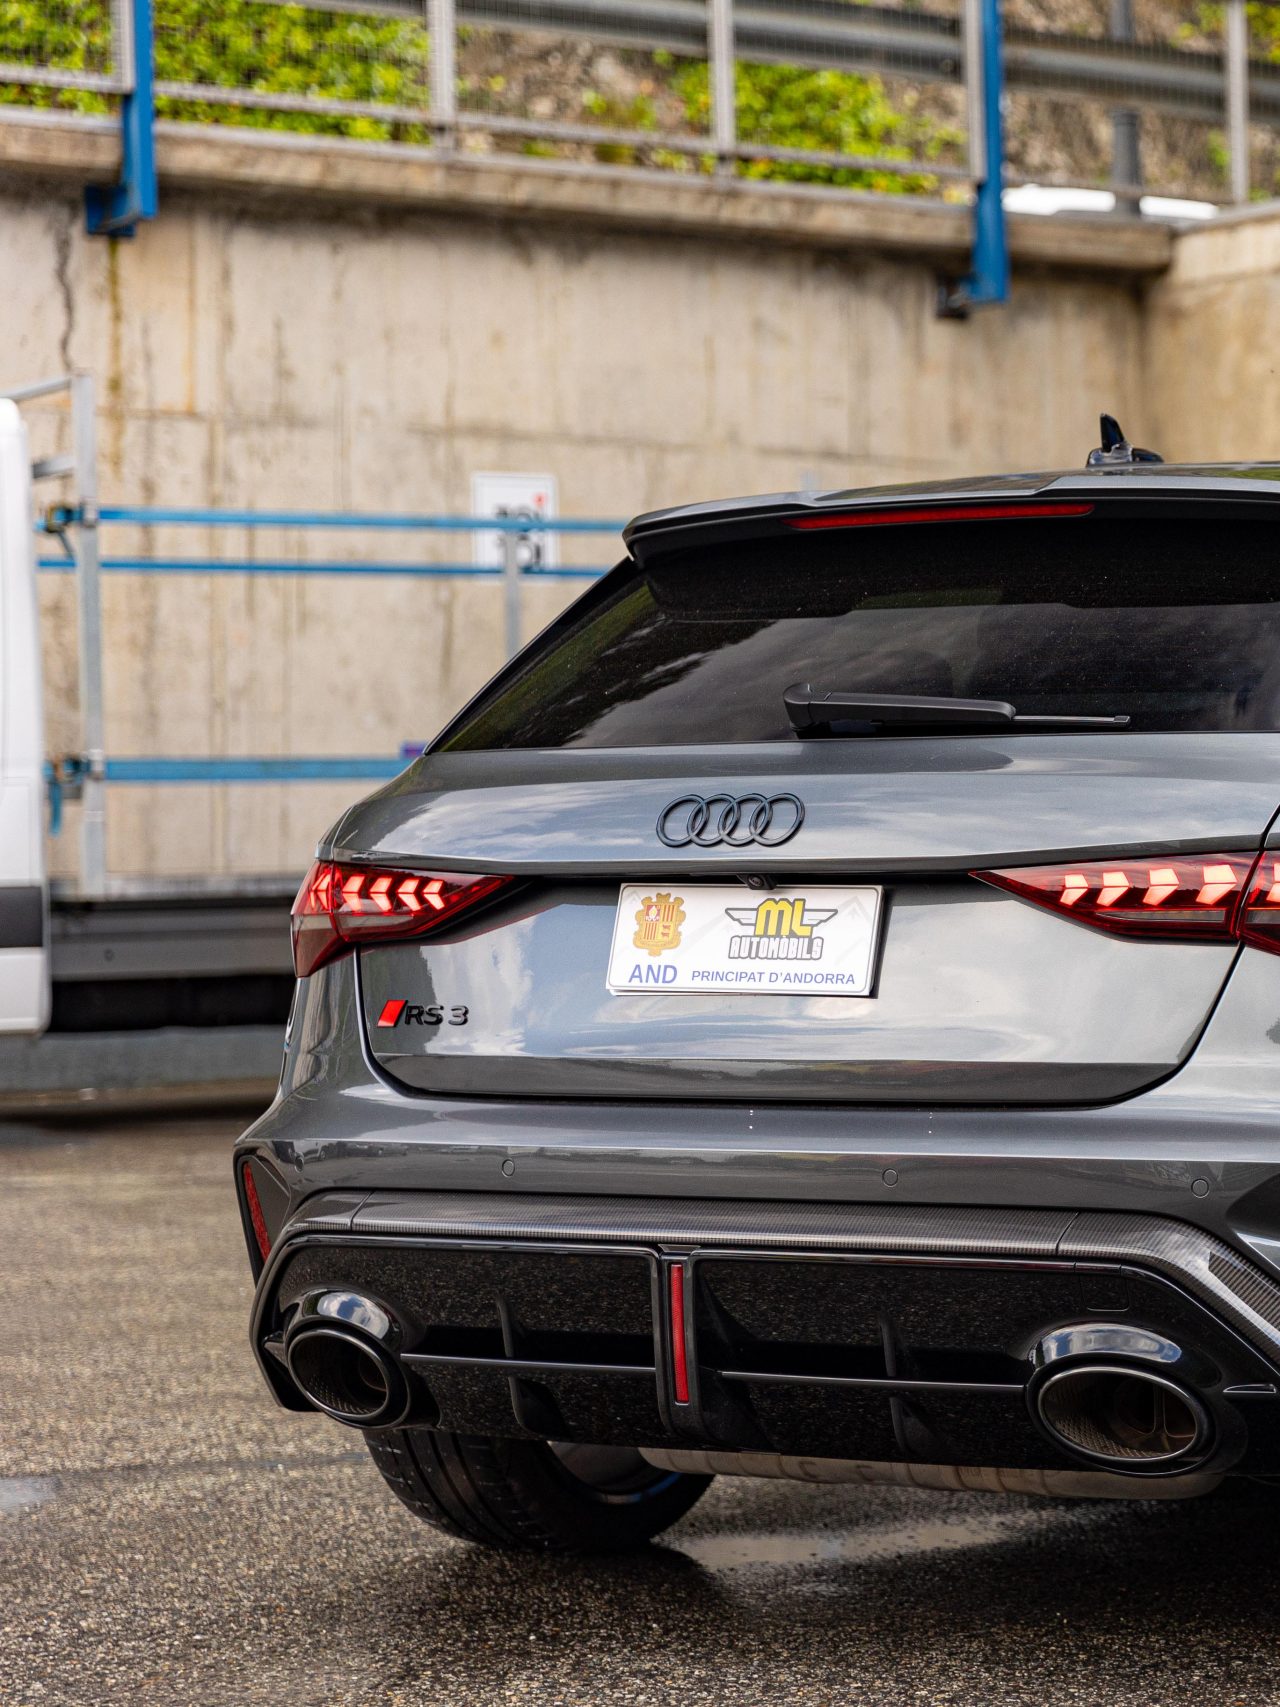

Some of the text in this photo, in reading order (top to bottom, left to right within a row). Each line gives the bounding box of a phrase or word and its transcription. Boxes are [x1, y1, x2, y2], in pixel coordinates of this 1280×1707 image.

[754, 898, 813, 936] ML
[628, 964, 678, 984] AND
[691, 970, 856, 985] PRINCIPAT D'ANDORRA
